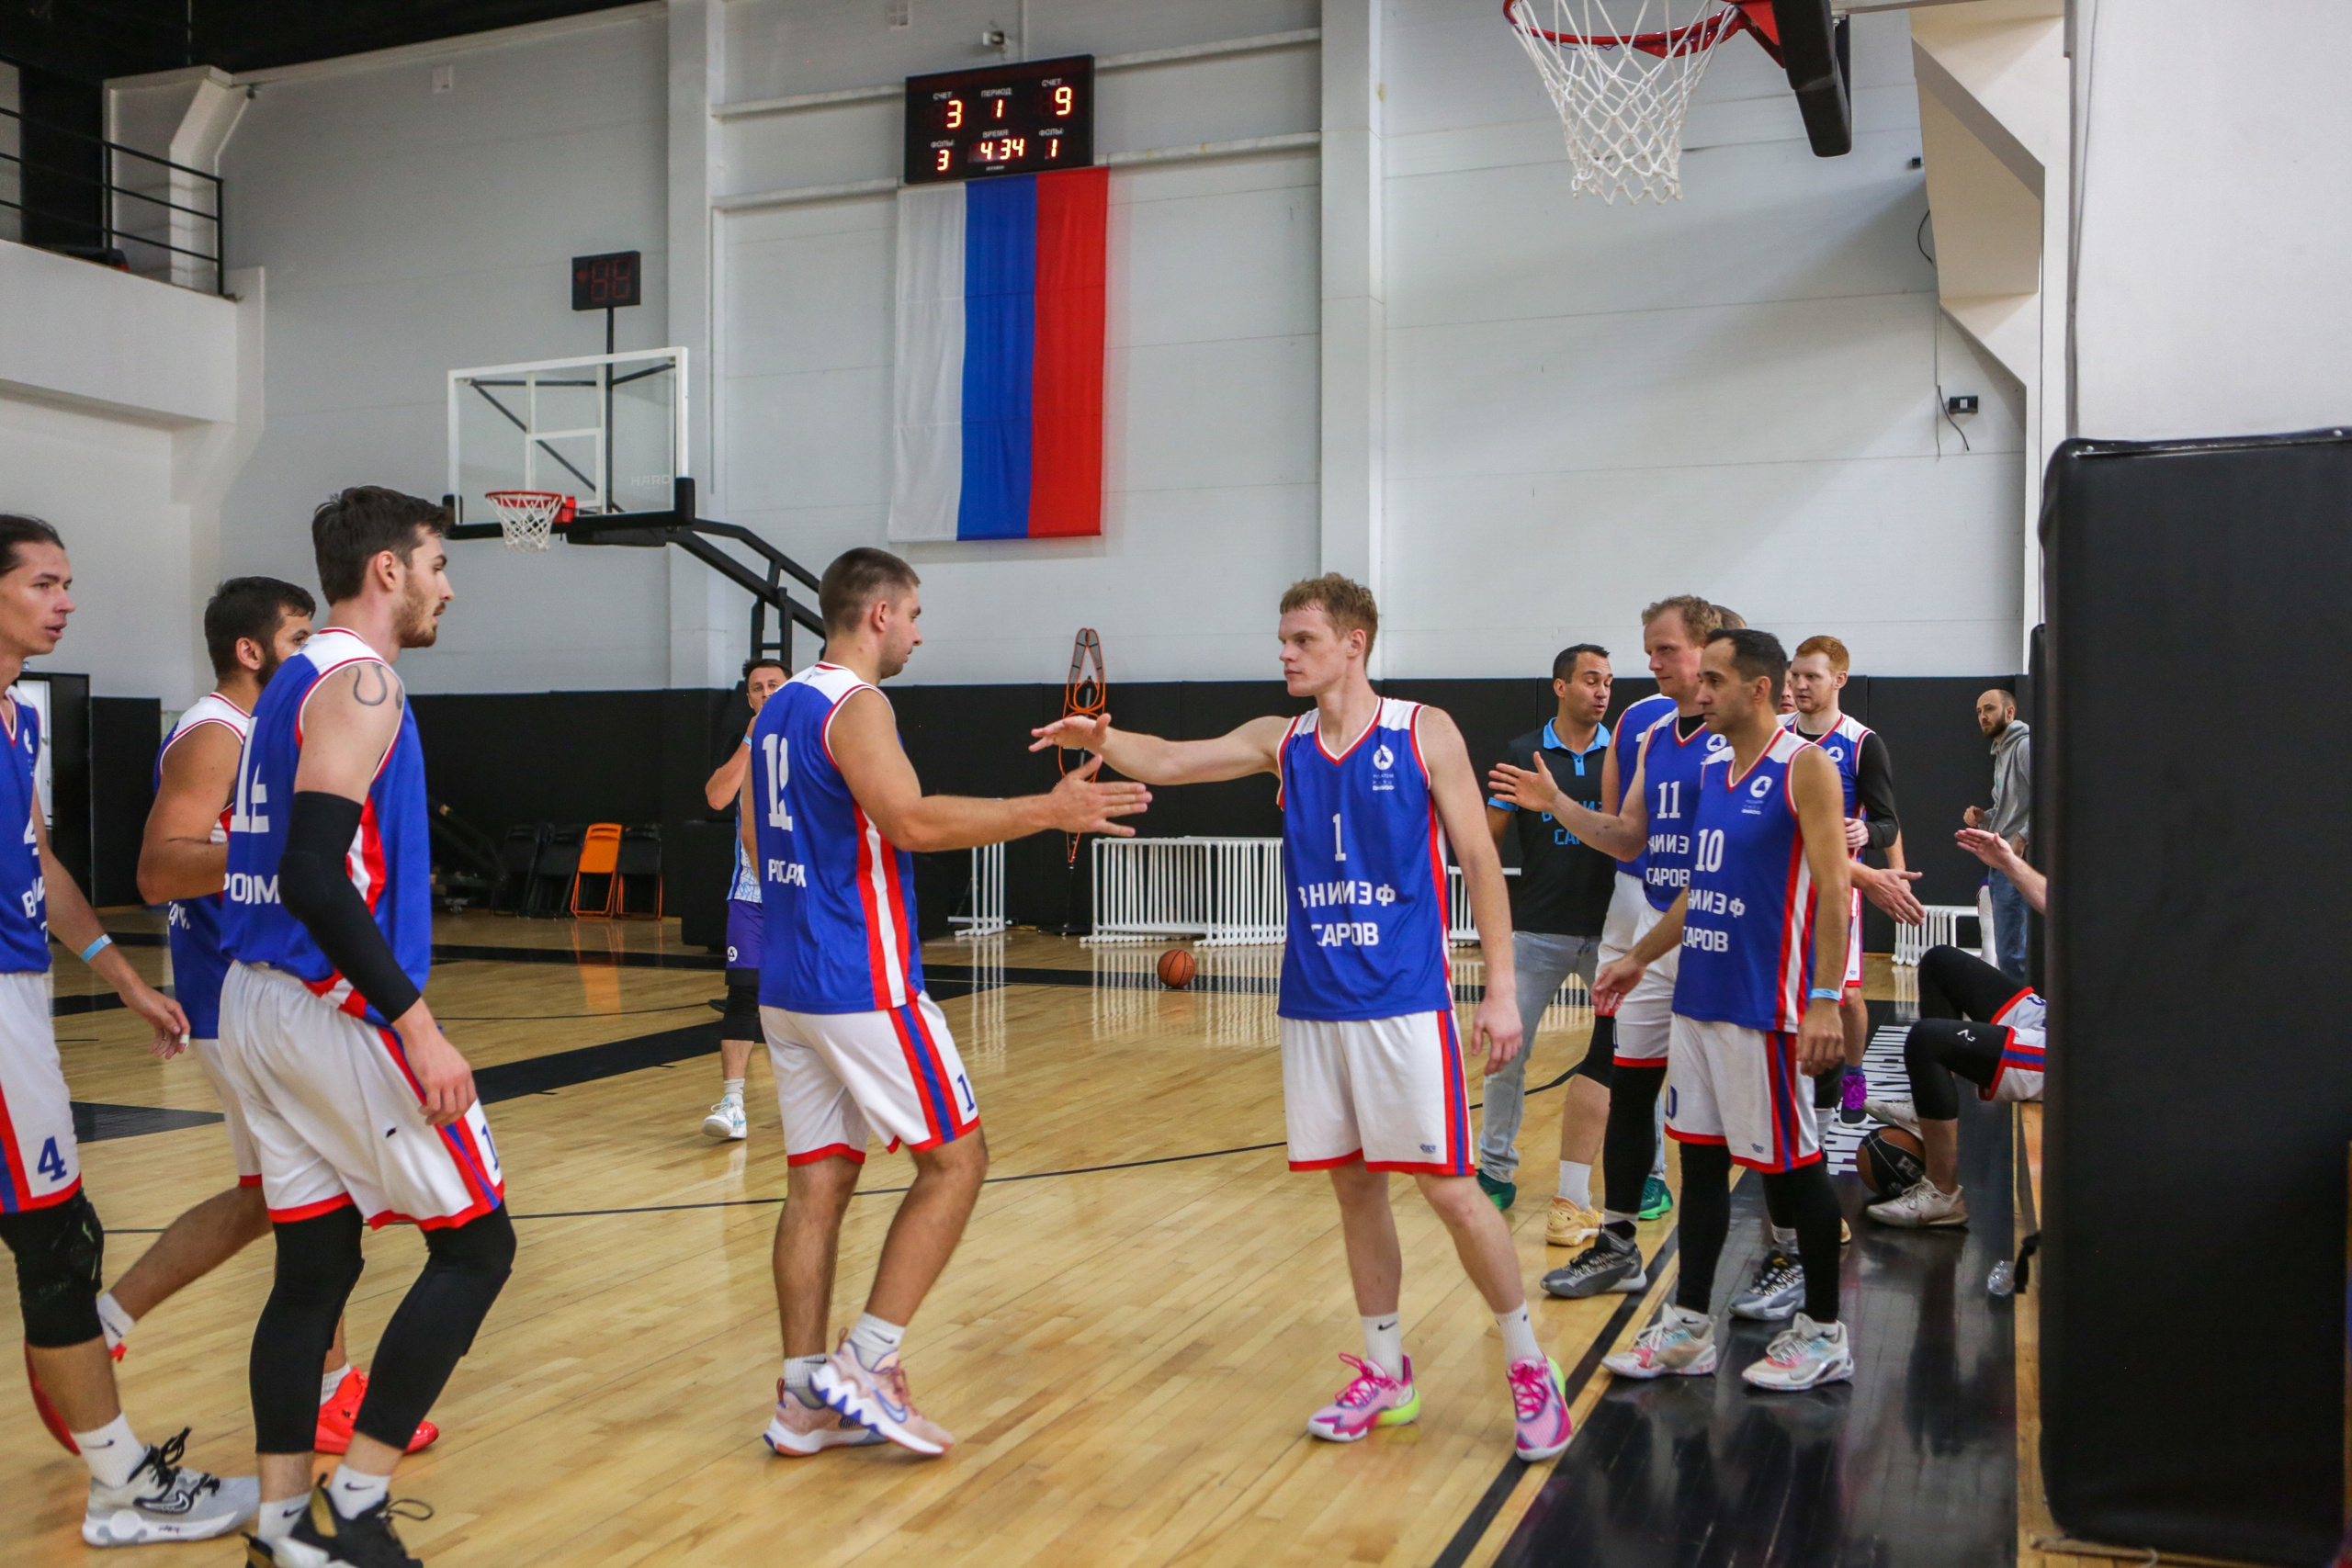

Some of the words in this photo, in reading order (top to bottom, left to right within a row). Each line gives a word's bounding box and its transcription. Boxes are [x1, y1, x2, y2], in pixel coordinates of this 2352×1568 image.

[980, 87, 1012, 97] ПЕРИОД
[1055, 86, 1072, 116] 9
[946, 99, 963, 129] 3
[996, 99, 1003, 118] 1
[982, 130, 1010, 139] ВРЕМЯ
[937, 149, 949, 171] 3
[631, 474, 671, 486] HARD
[1657, 781, 1680, 819] 11
[1332, 813, 1347, 862] 1
[1694, 829, 1724, 873] 10
[1646, 867, 1690, 887] САРОВ
[38, 1135, 67, 1182] 4
